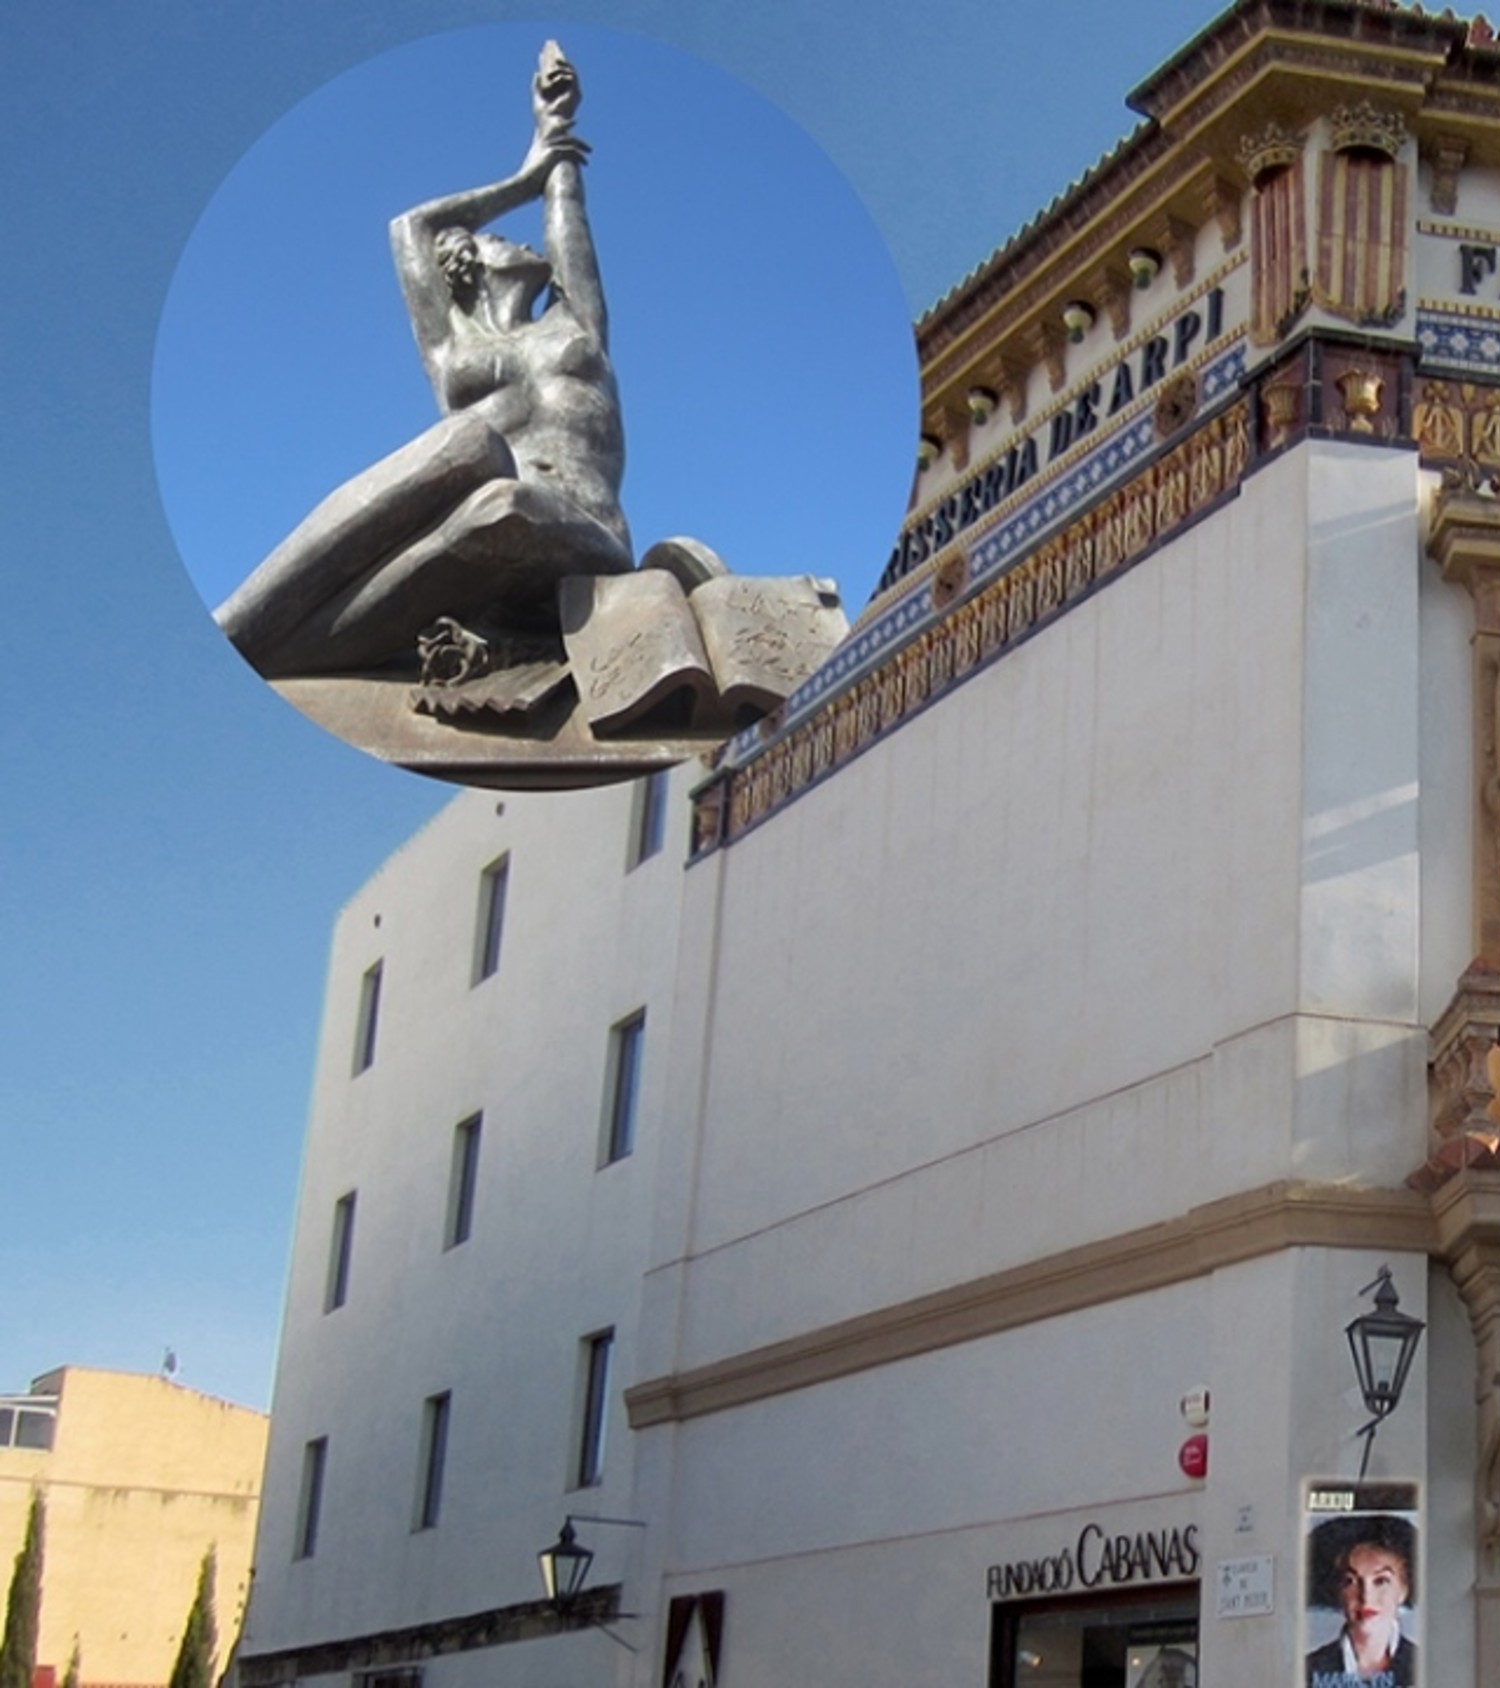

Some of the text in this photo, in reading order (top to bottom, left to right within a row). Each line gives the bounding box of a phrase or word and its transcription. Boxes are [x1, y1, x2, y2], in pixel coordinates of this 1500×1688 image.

[1048, 380, 1102, 464] DE
[1106, 287, 1225, 418] ARPI
[985, 1522, 1199, 1599] FUNDACIÓ CABANAS
